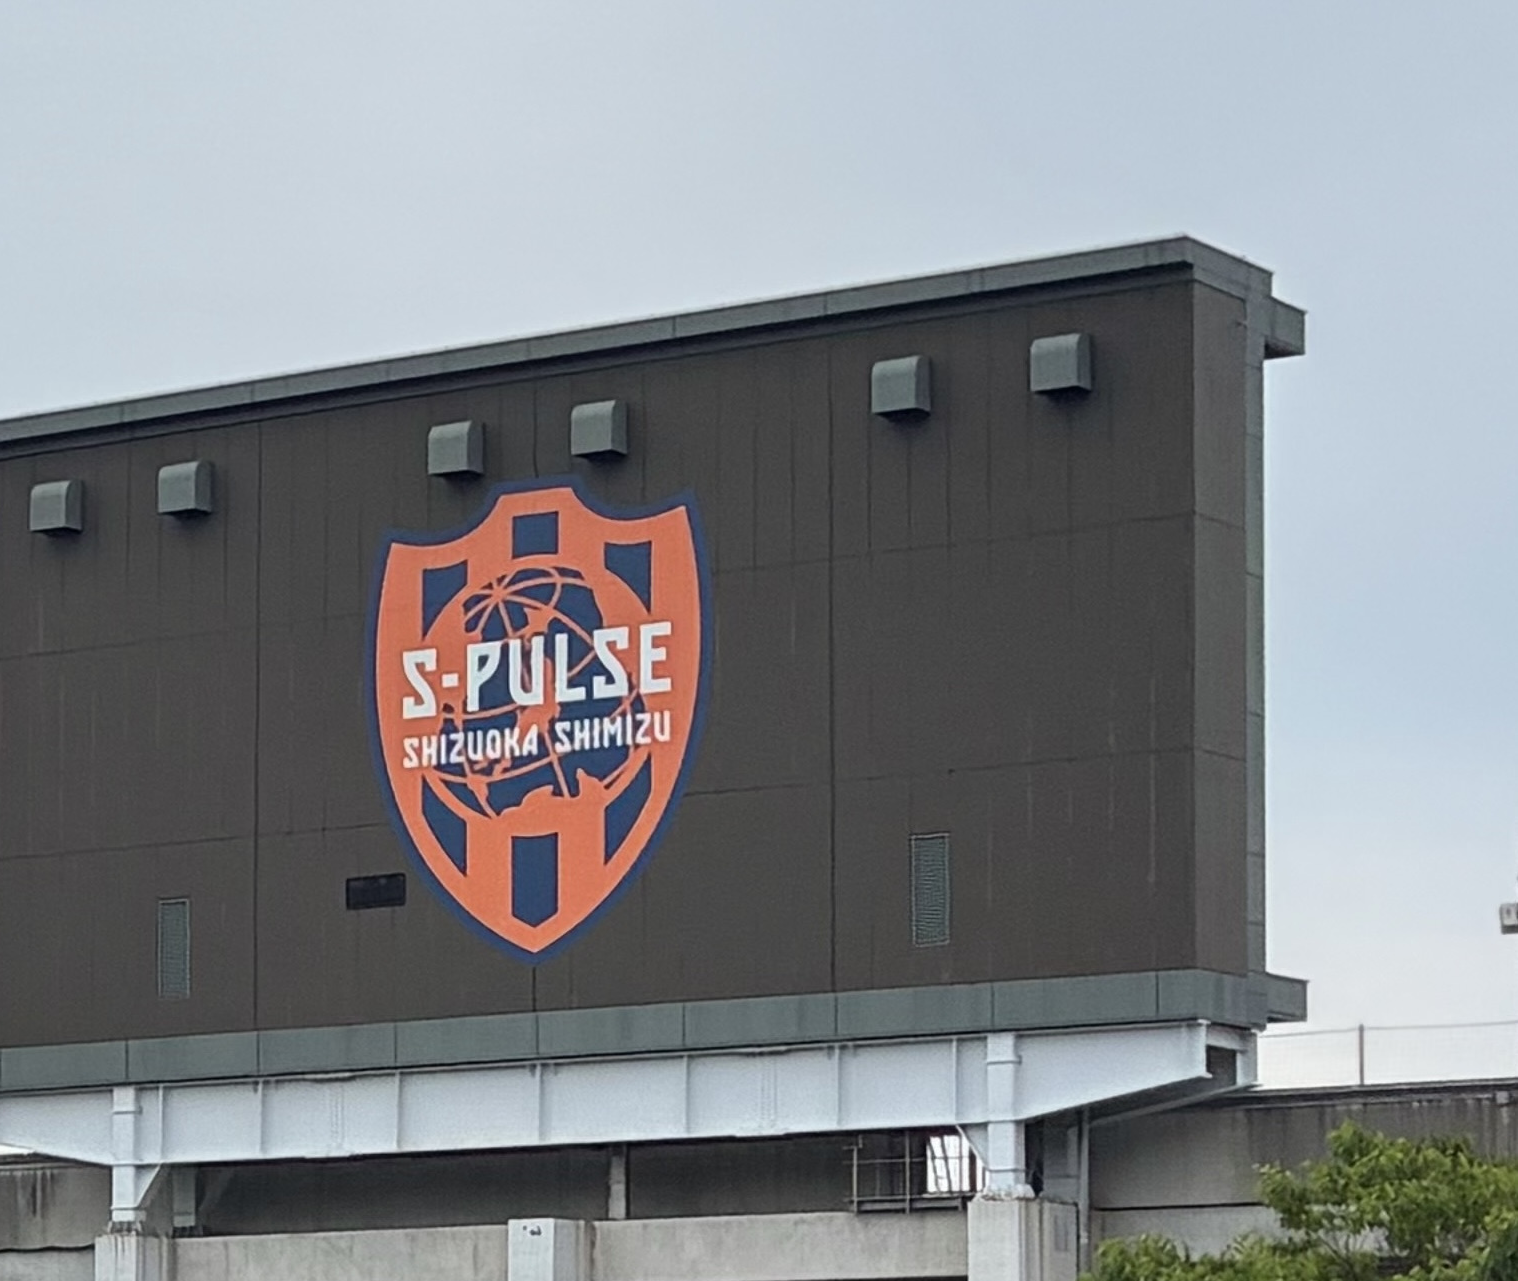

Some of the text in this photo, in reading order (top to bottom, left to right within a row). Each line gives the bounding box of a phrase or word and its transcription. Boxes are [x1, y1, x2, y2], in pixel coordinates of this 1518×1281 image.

[402, 622, 672, 719] S-PULSE
[402, 711, 671, 769] SHIZUOKA SHIMIZU
